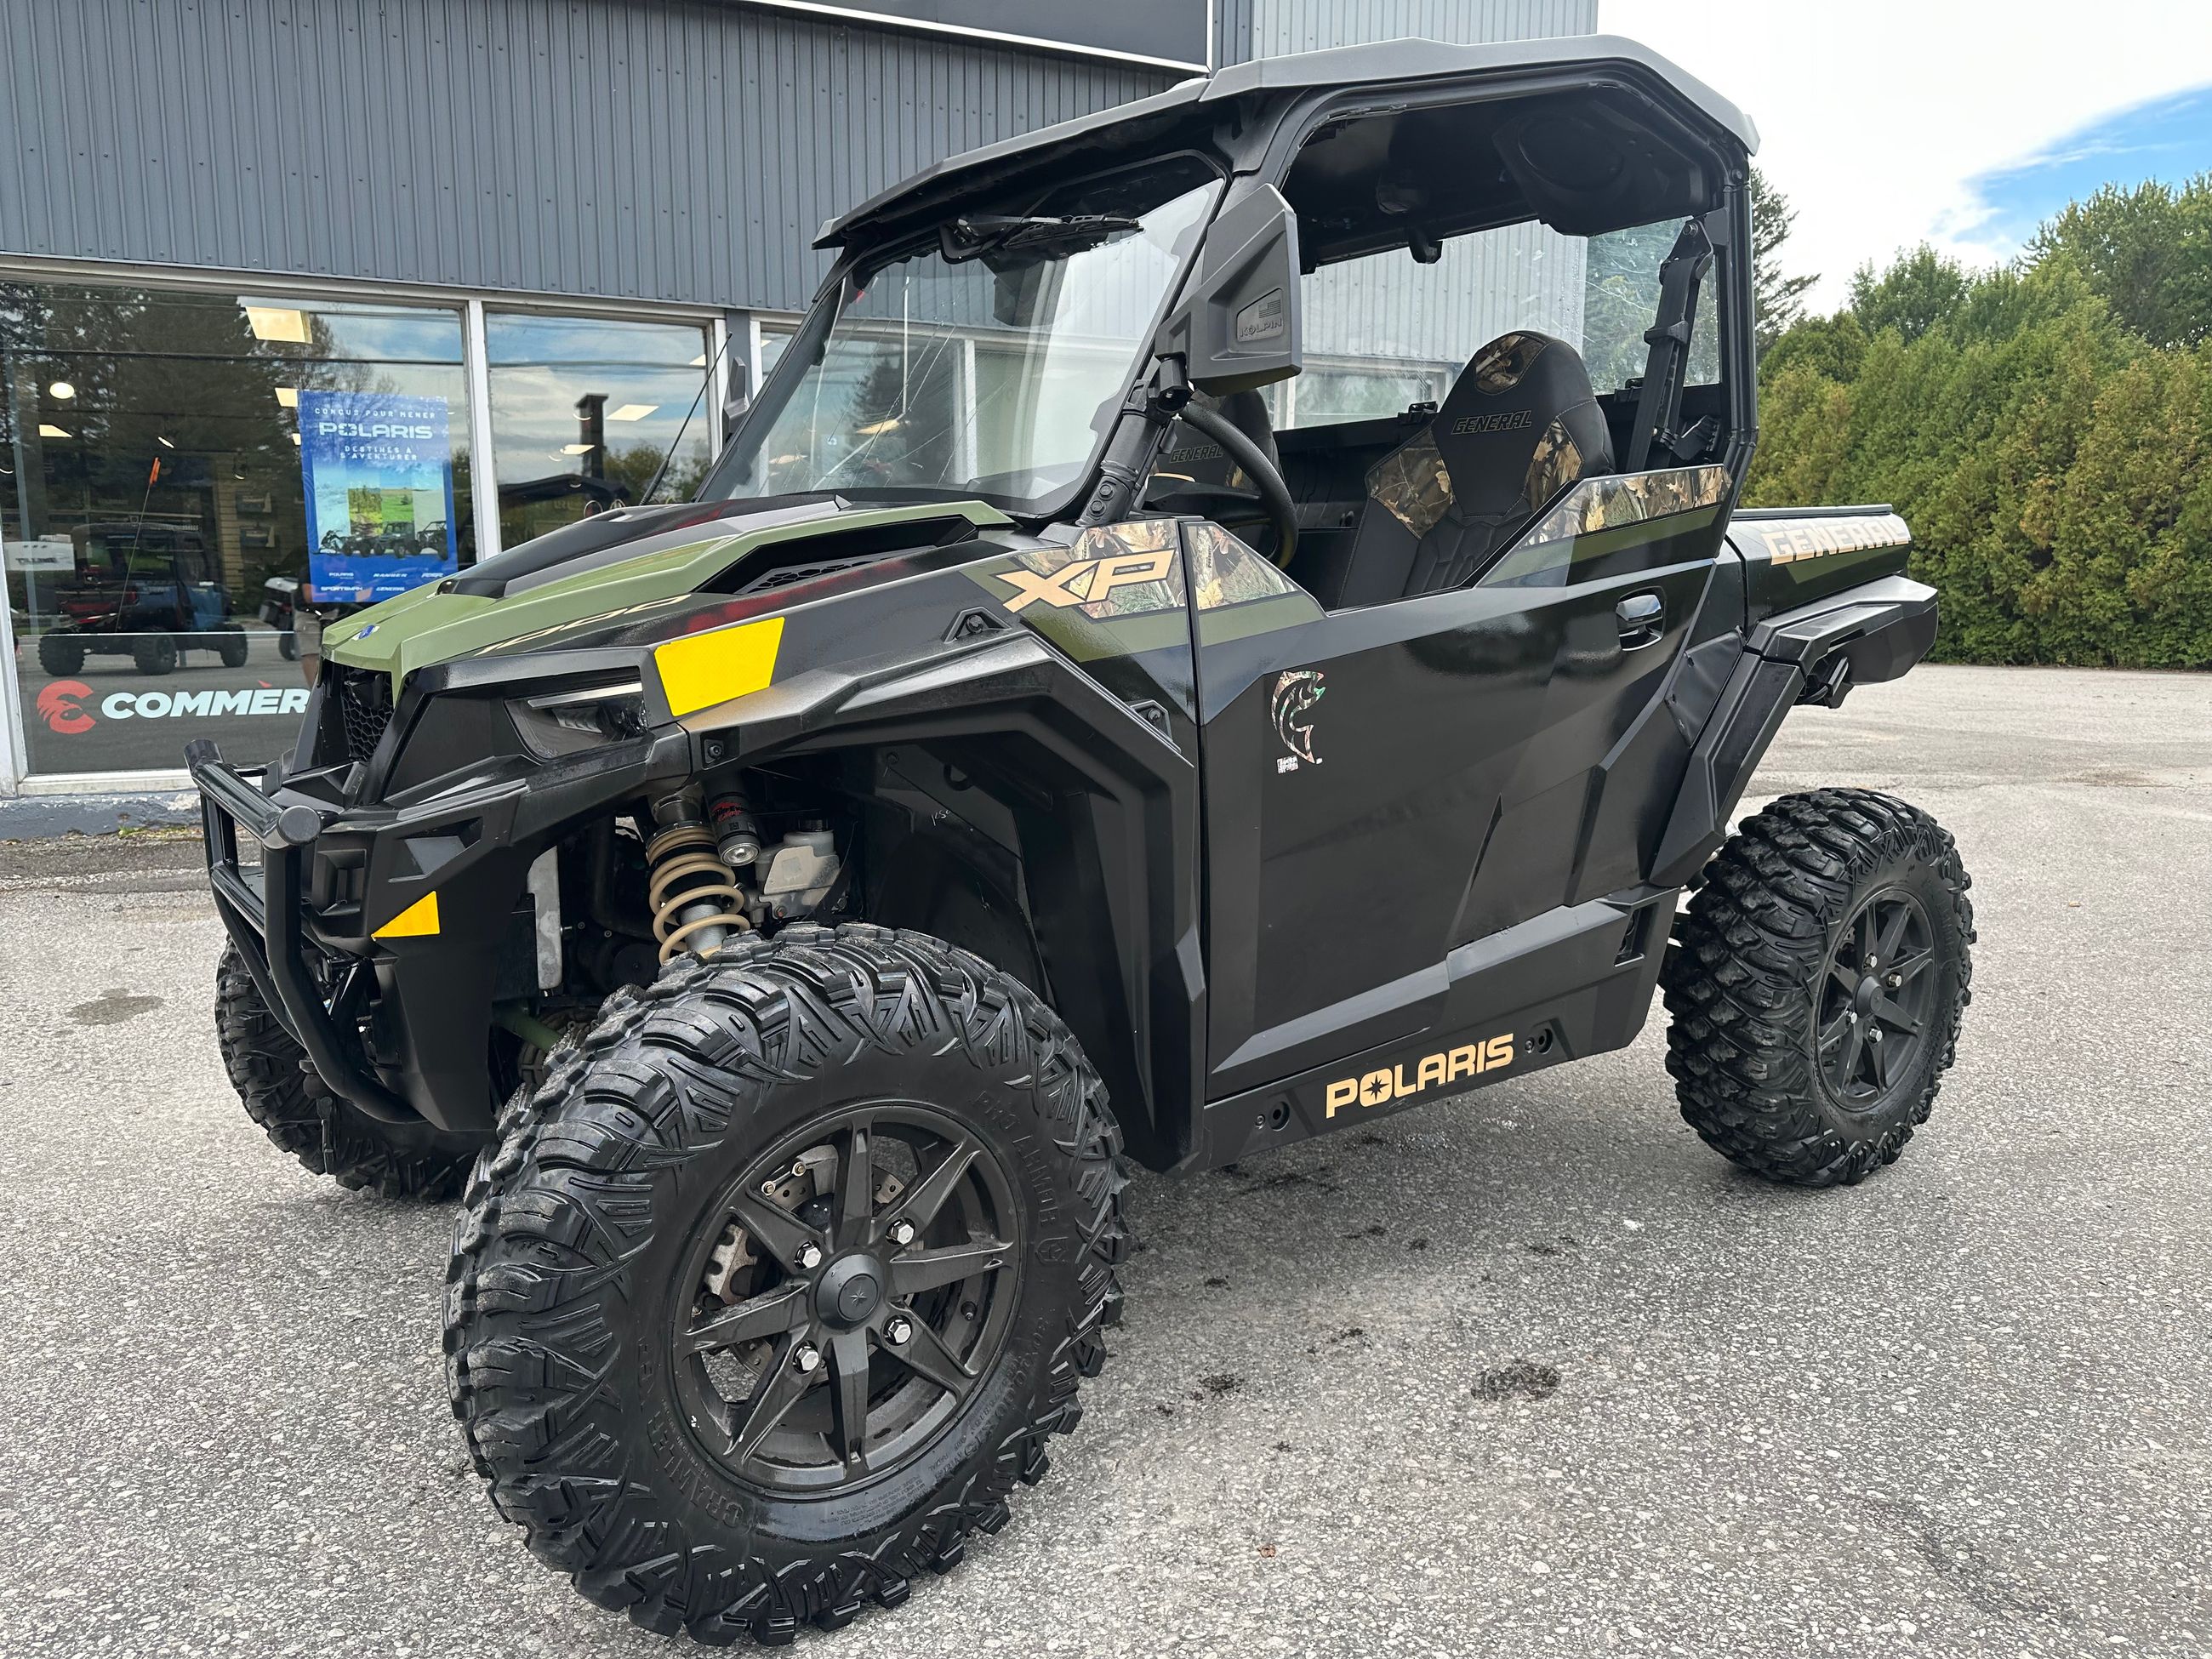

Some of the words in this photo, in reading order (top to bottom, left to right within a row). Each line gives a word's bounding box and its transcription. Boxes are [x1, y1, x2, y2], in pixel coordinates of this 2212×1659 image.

[1239, 317, 1282, 338] KOLPIN
[319, 422, 433, 439] POLARIS
[1451, 410, 1531, 435] GENERAL
[1170, 443, 1223, 463] GENERAL
[1761, 516, 1912, 566] GENERAL
[993, 548, 1177, 614] XP
[473, 594, 692, 658] 1000
[1325, 1033, 1514, 1119] POLARIS
